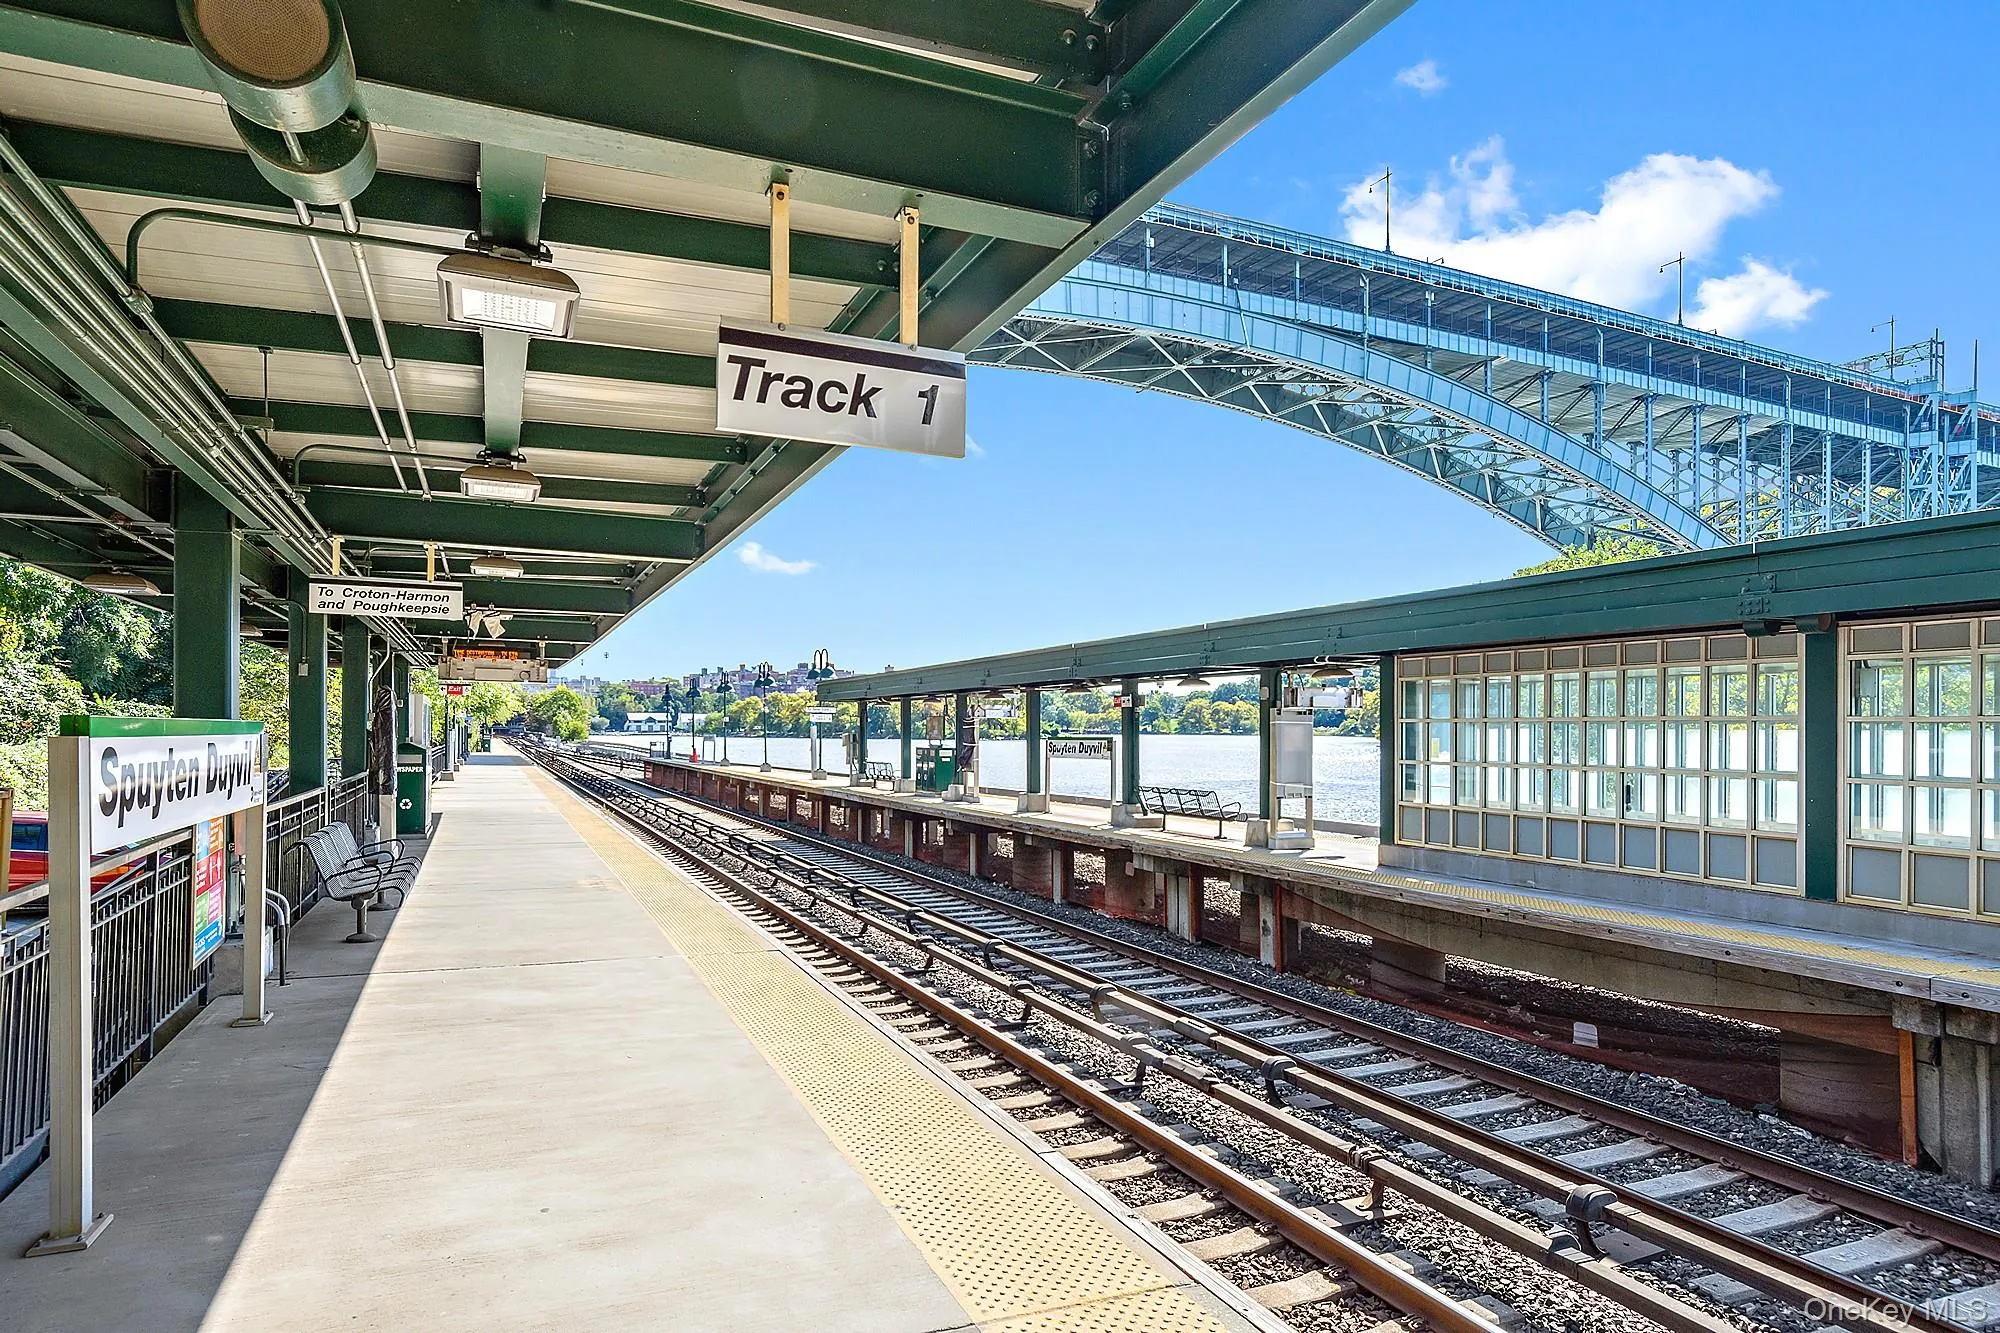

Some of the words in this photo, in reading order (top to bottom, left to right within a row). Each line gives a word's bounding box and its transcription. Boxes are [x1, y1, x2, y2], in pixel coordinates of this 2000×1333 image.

[727, 354, 883, 418] Track
[917, 384, 940, 425] 1
[318, 586, 334, 597] To
[342, 587, 450, 602] Croton-Harmon
[317, 600, 346, 610] and
[353, 600, 450, 615] Poughkeepsie
[1048, 741, 1077, 755] Spuyten
[1078, 742, 1103, 756] Duyvil
[99, 746, 200, 828] Spuyten
[205, 740, 252, 800] Duyvil
